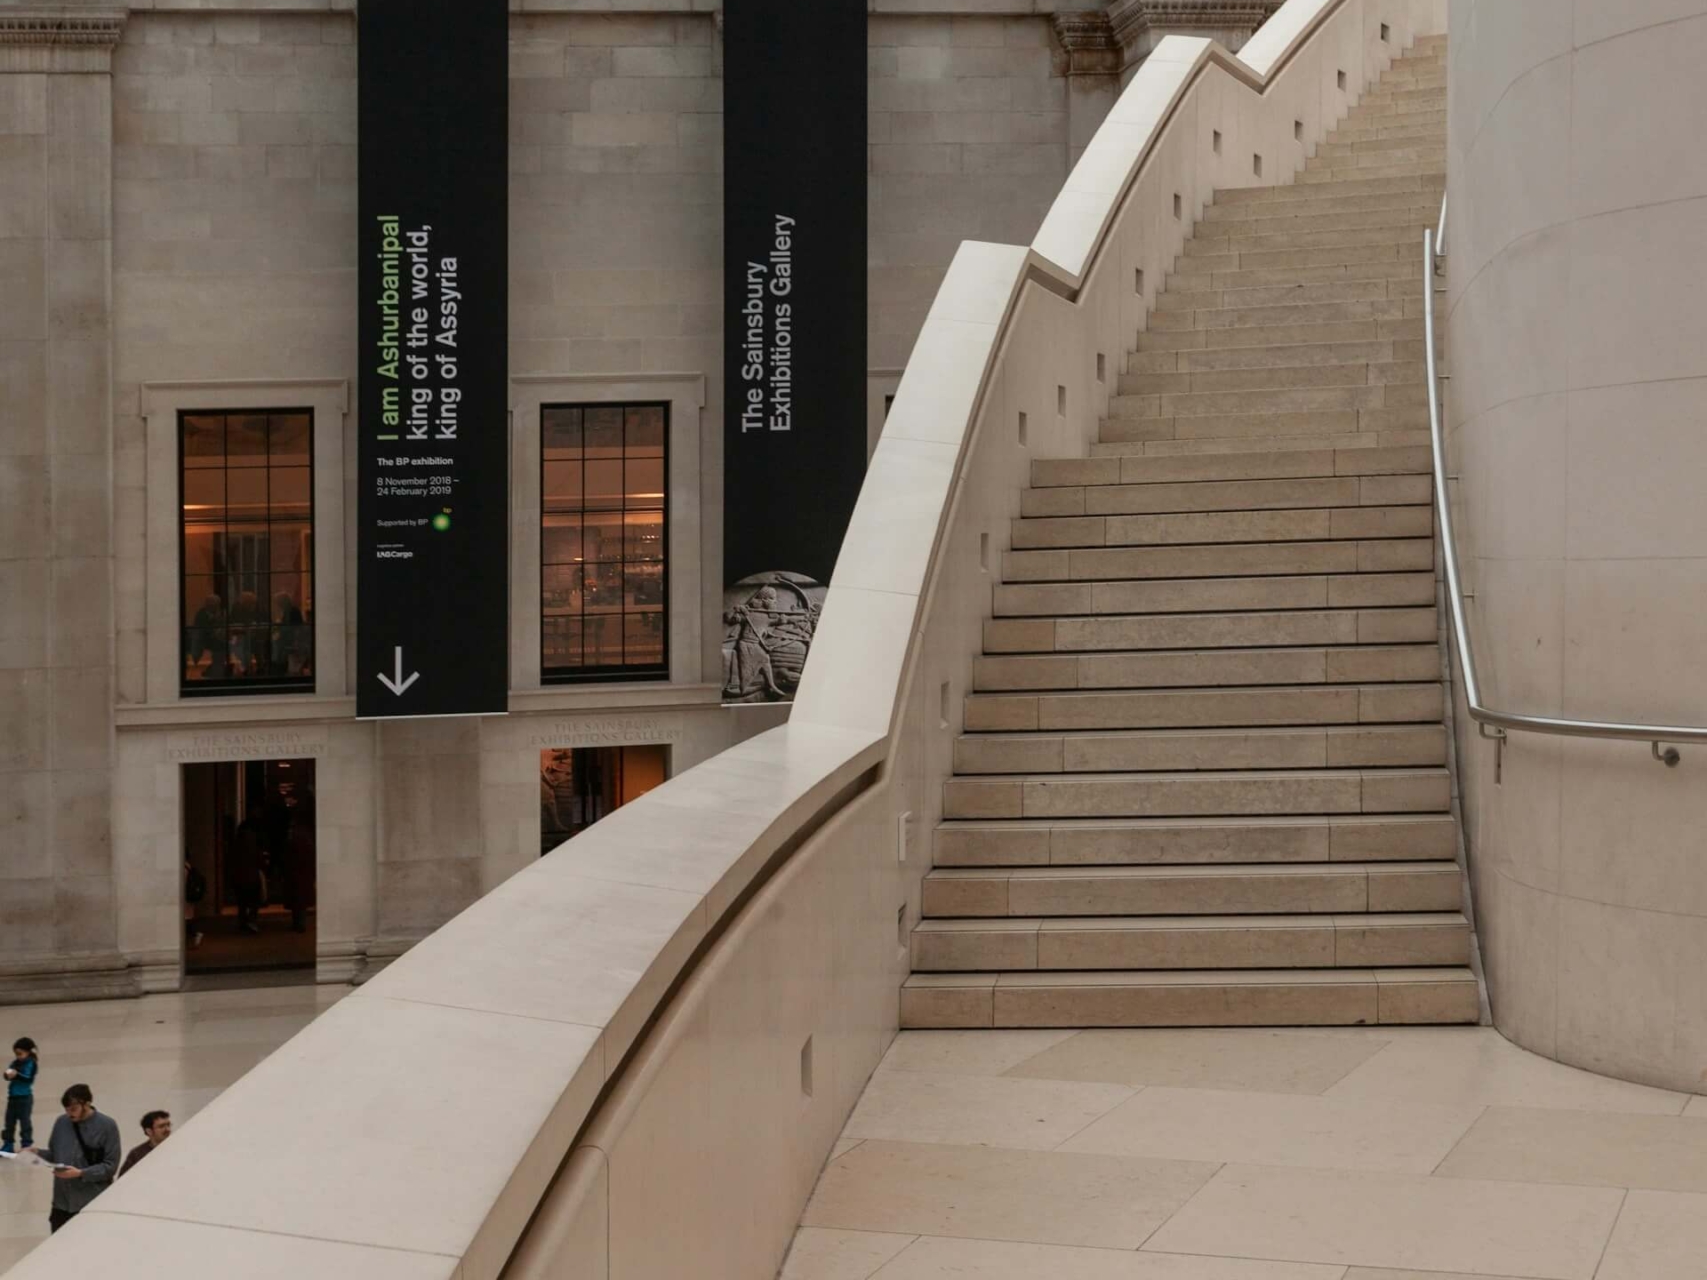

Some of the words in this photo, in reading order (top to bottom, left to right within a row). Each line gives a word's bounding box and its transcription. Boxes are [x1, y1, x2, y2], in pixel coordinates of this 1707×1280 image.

[406, 224, 431, 300] world,
[769, 214, 795, 297] Gallery
[377, 215, 403, 380] Ashurbanipal
[435, 257, 462, 348] Assyria
[406, 307, 428, 348] the
[742, 261, 767, 381] Sainsbury
[406, 354, 428, 380] of
[435, 353, 457, 380] of
[770, 303, 791, 431] Exhibitions
[382, 387, 399, 425] am
[406, 388, 432, 440] king
[435, 388, 461, 440] king
[742, 388, 763, 433] The
[376, 457, 394, 466] The
[395, 457, 410, 466] BP
[411, 456, 454, 466] exhibition
[376, 477, 384, 486] 8
[385, 477, 428, 486] November
[429, 476, 452, 485] 2018
[376, 487, 389, 496] 24
[390, 487, 428, 497] February
[429, 486, 452, 495] 2019
[376, 519, 409, 528] Supported
[409, 519, 417, 527] by
[417, 518, 429, 526] BP
